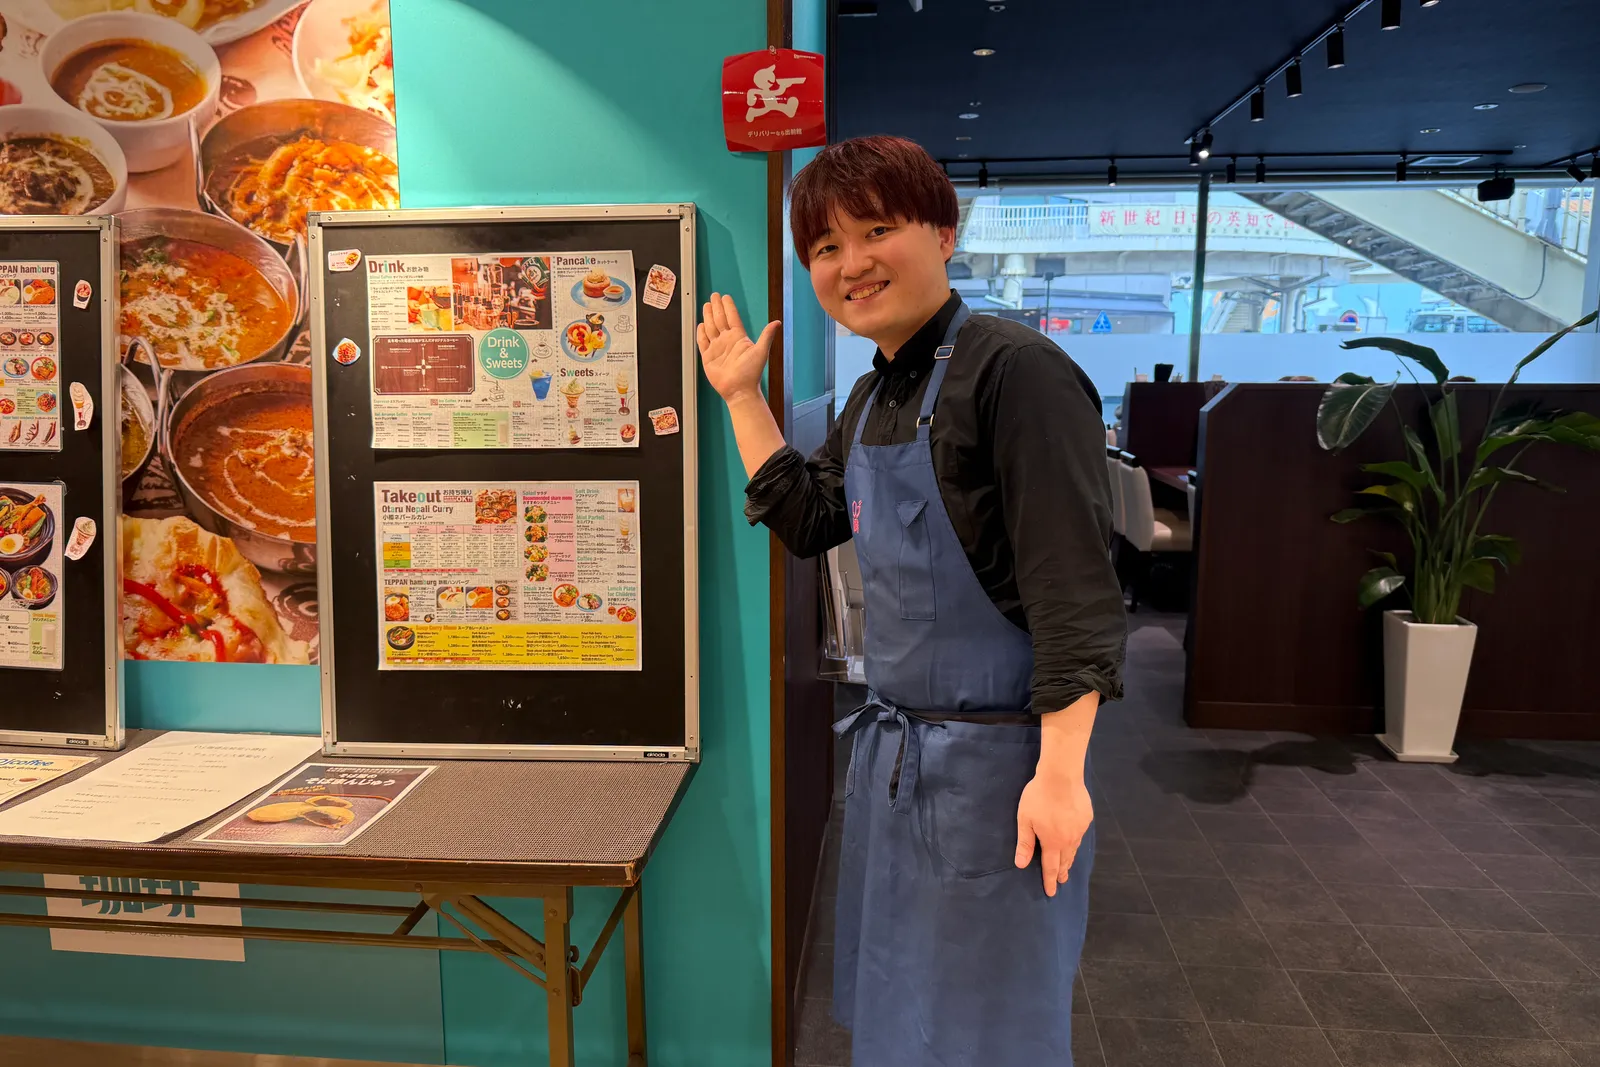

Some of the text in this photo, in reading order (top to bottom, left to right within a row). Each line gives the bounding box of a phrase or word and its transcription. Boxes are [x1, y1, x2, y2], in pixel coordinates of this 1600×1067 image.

[1100, 210, 1161, 226] 新世紀
[369, 259, 405, 273] Drink
[557, 256, 596, 265] Pancake
[21, 265, 55, 274] hamburg
[488, 336, 520, 348] Drink
[499, 348, 508, 359] &
[486, 358, 522, 369] Sweets
[560, 367, 594, 377] Sweets
[381, 489, 441, 503] Takeout
[382, 505, 454, 515] Otaru Nepali Curry
[305, 776, 396, 787] そばまんじゅう
